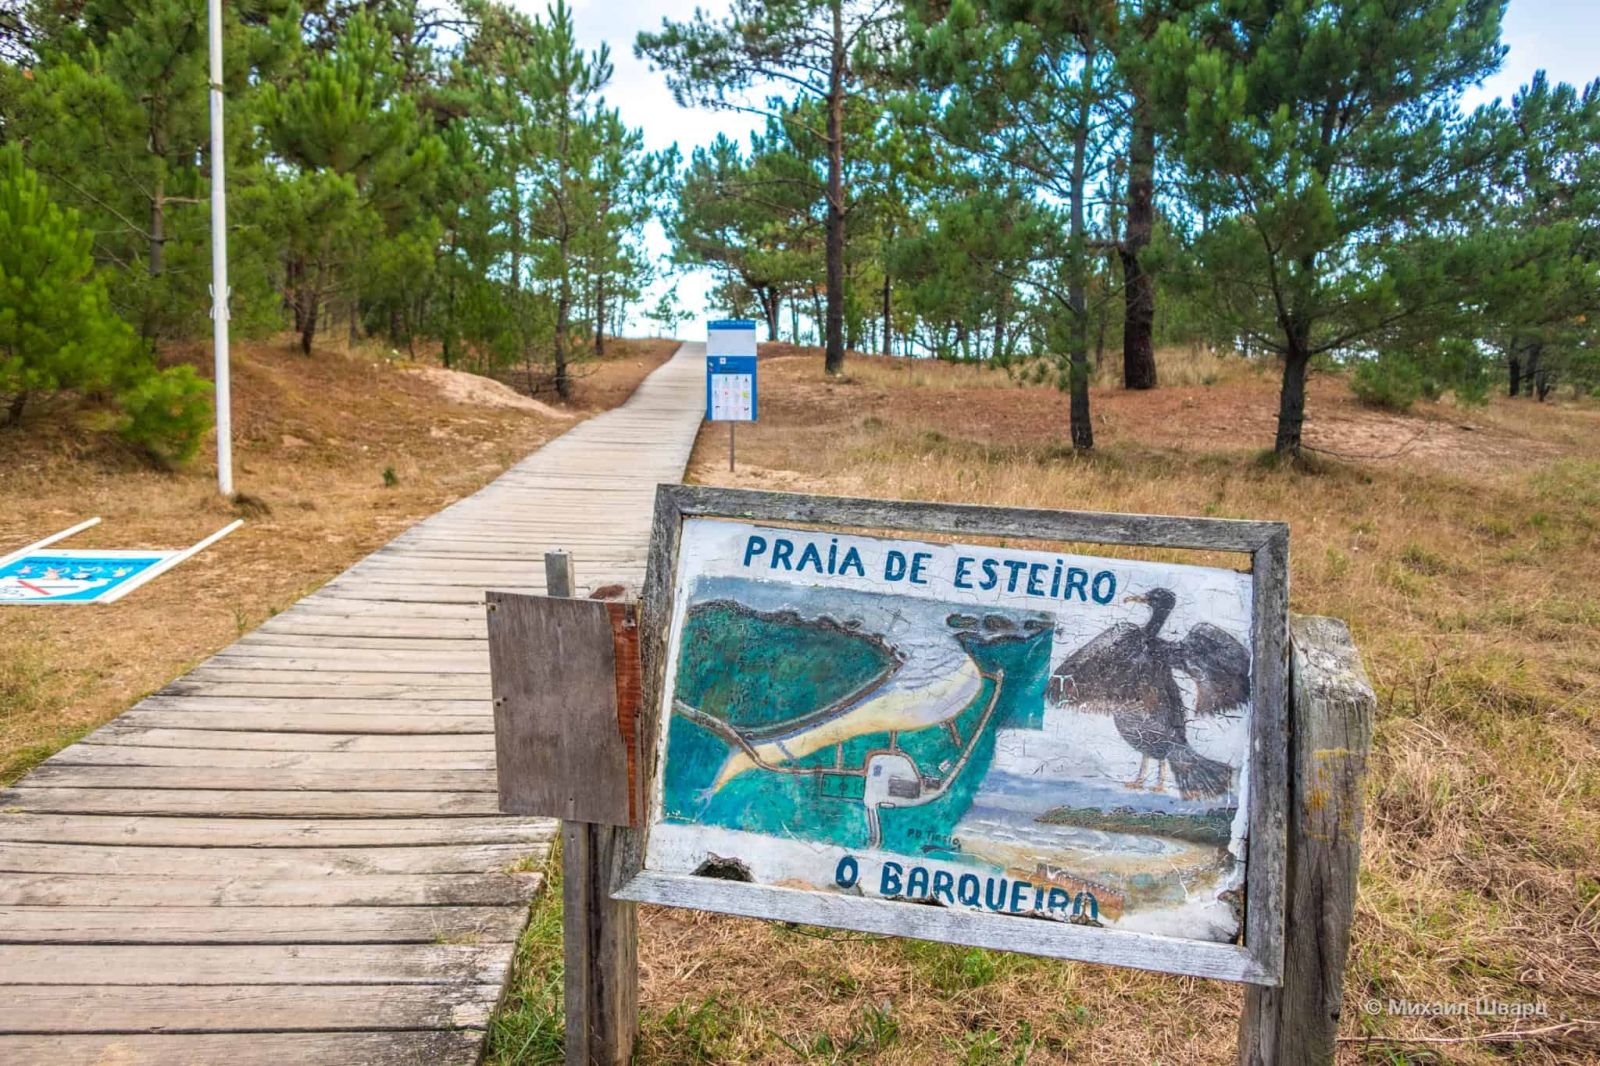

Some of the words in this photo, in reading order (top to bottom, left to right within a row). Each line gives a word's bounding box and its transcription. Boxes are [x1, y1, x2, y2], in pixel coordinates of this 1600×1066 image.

[884, 550, 932, 584] DE
[835, 854, 859, 889] O
[879, 860, 1099, 920] BARQUEIRO
